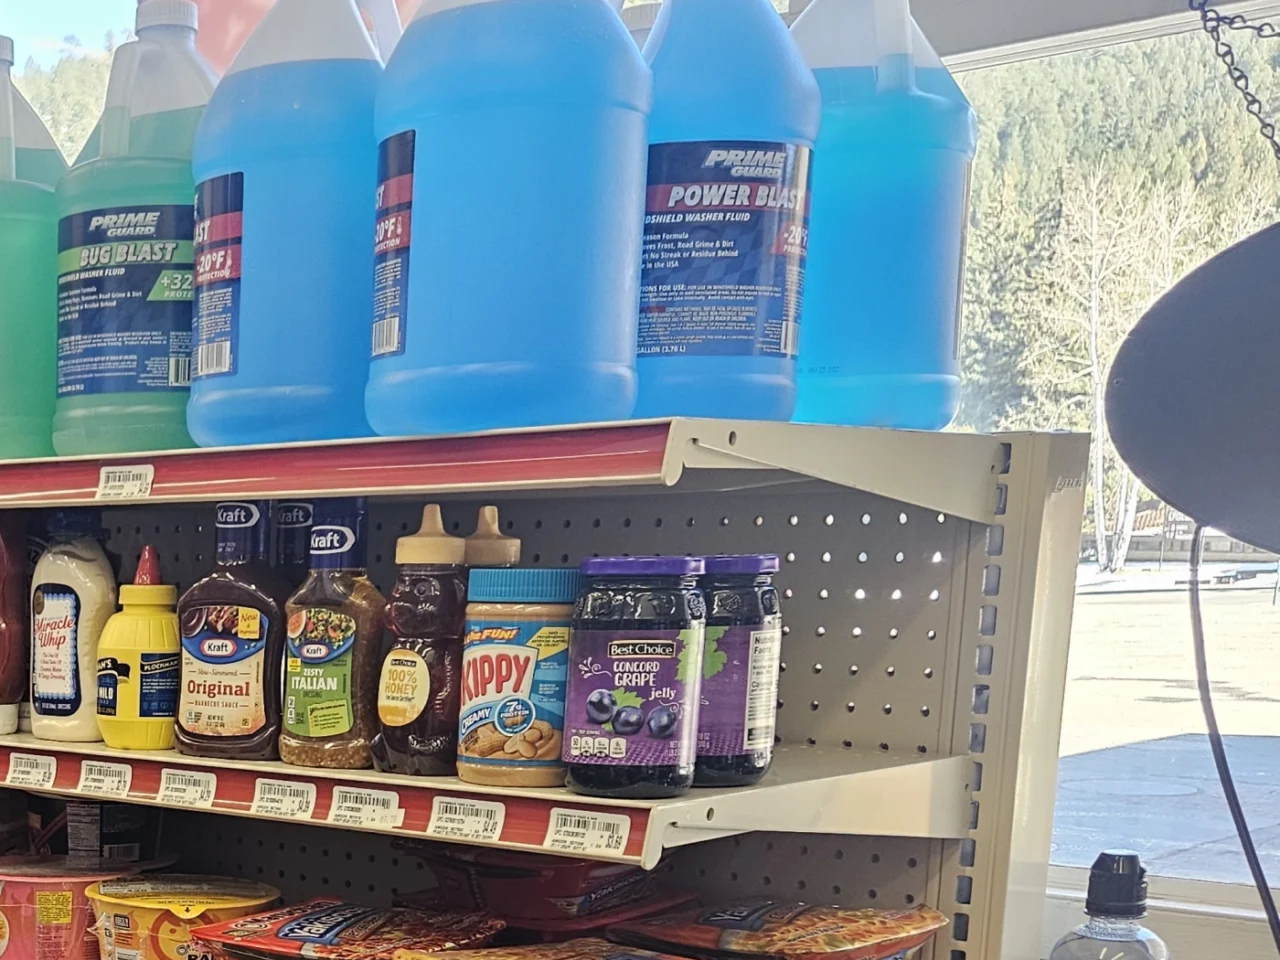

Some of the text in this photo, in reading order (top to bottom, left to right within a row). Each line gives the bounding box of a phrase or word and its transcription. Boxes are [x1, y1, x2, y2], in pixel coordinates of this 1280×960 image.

[703, 150, 786, 167] PRIME
[731, 166, 782, 178] GUARD
[668, 184, 803, 210] POWER BLAST
[89, 212, 160, 230] PRIME
[685, 213, 750, 222] WASHER FLUID
[107, 227, 155, 237] GUARD
[658, 242, 675, 250] Frost,
[80, 243, 177, 267] BUG BLAST
[105, 268, 125, 276] FLUID
[216, 508, 246, 523] Kraft
[311, 532, 340, 548] Kraft
[39, 631, 66, 650] Whip
[207, 641, 228, 652] Kraft
[306, 646, 322, 656] Kraft
[611, 643, 673, 655] Best Choice
[197, 669, 238, 677] Slow-Simmered
[303, 668, 324, 677] ZESTY
[613, 661, 660, 673] CONCORD
[388, 669, 417, 683] 100%
[614, 672, 657, 687] GRAPE
[187, 681, 250, 698] Original
[291, 676, 337, 691] ITALIAN
[385, 682, 417, 696] HONEY
[649, 687, 677, 700] jelly
[461, 707, 491, 735] CREAMY
